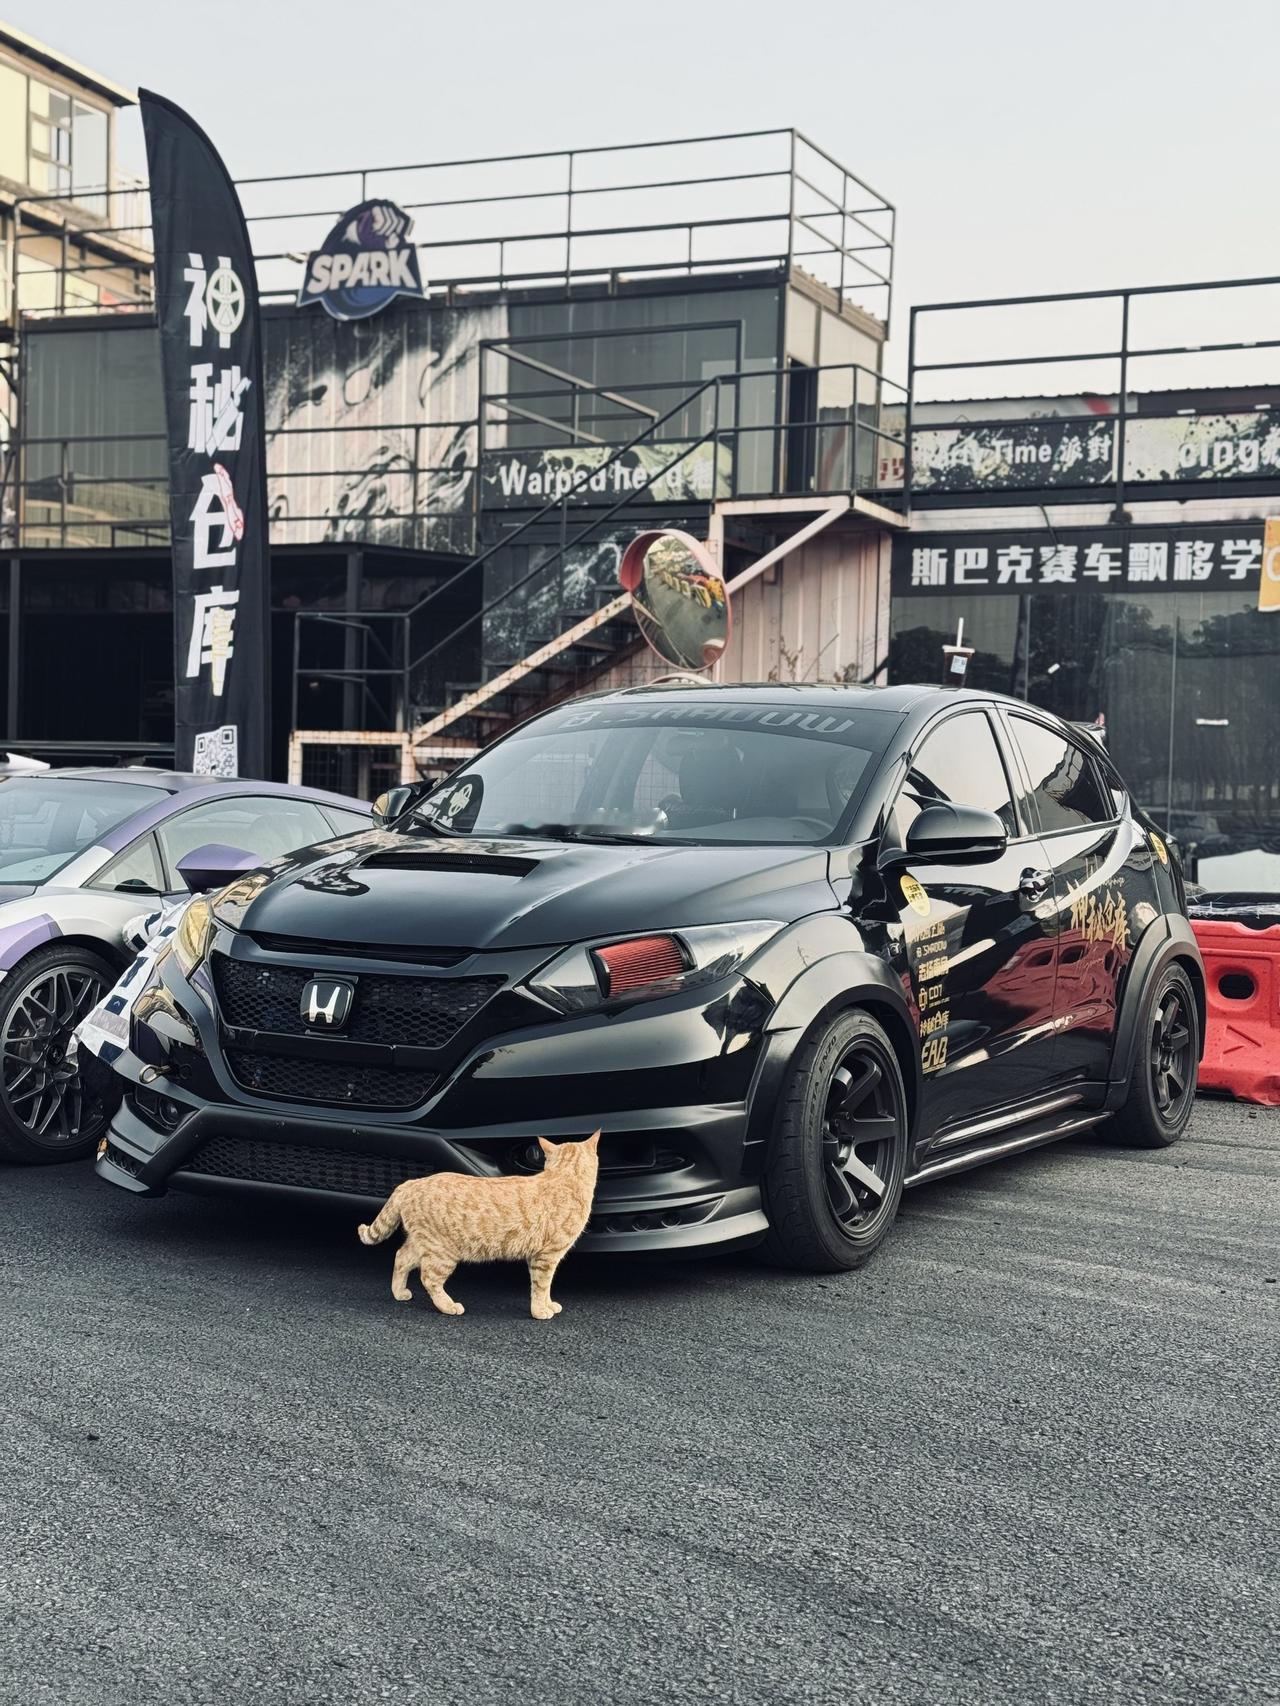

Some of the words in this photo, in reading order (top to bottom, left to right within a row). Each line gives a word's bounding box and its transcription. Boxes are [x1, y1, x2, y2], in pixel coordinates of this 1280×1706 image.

[306, 249, 418, 294] SPARK
[991, 437, 1052, 465] Time
[184, 253, 251, 697] 神秘仓库
[500, 457, 606, 500] Warped
[614, 459, 683, 491] hed
[911, 538, 1263, 586] 斯巴克赛车飘移学
